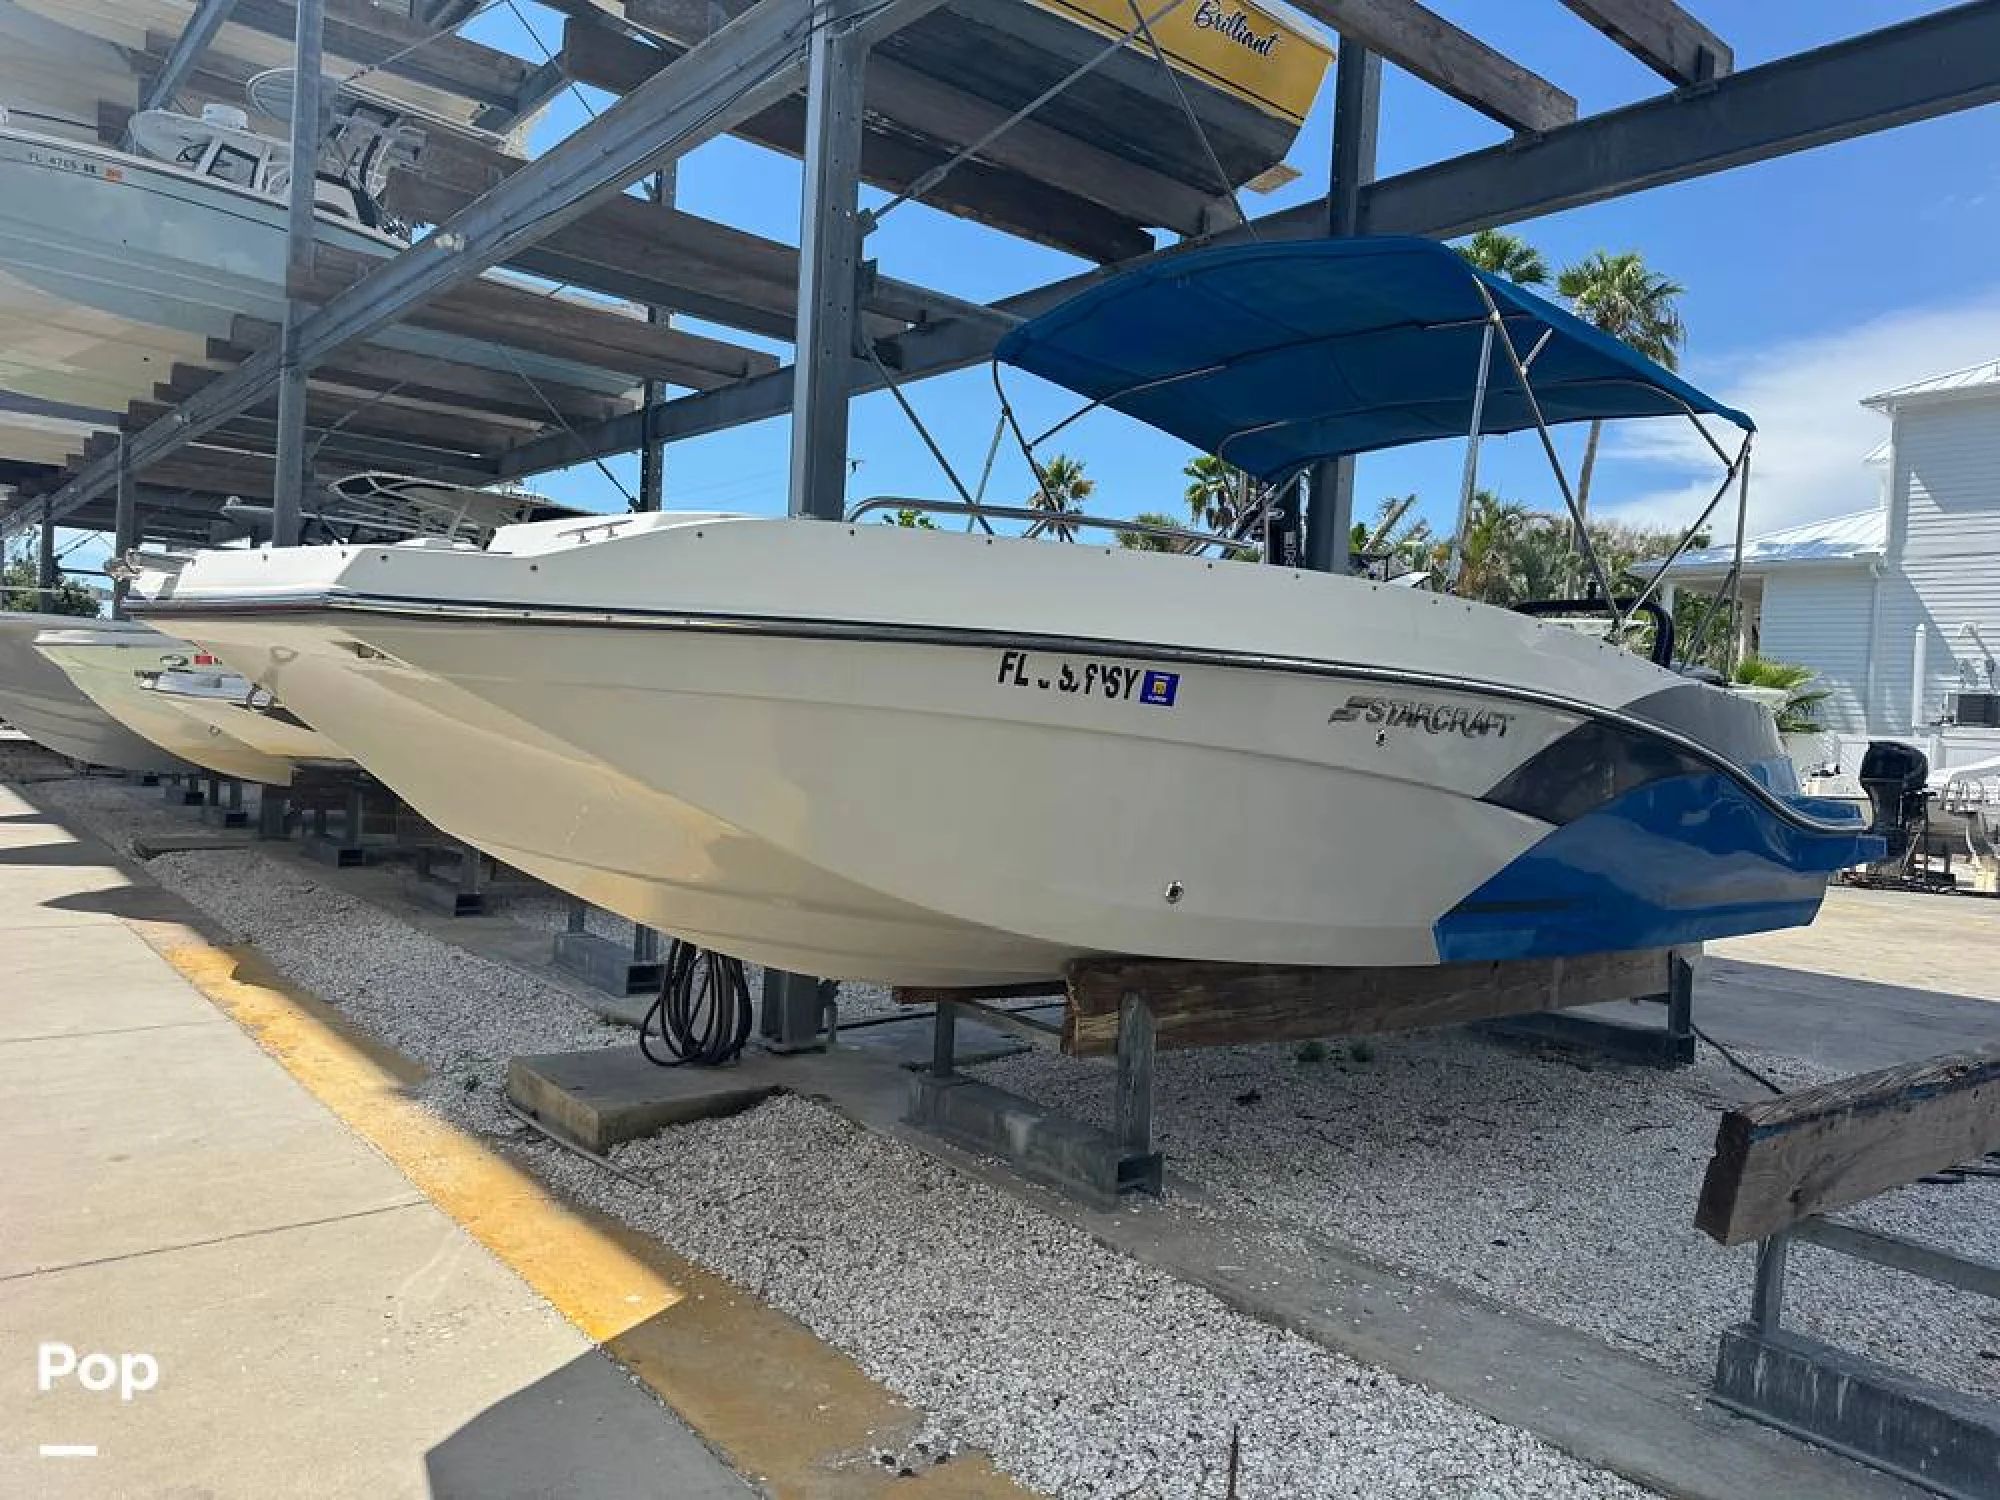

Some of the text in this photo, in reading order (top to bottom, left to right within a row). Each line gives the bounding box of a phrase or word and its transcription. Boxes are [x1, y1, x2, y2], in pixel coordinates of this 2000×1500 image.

[1193, 0, 1279, 56] Brilliant
[998, 651, 1029, 687] FL
[1364, 700, 1509, 738] STARCRAFT
